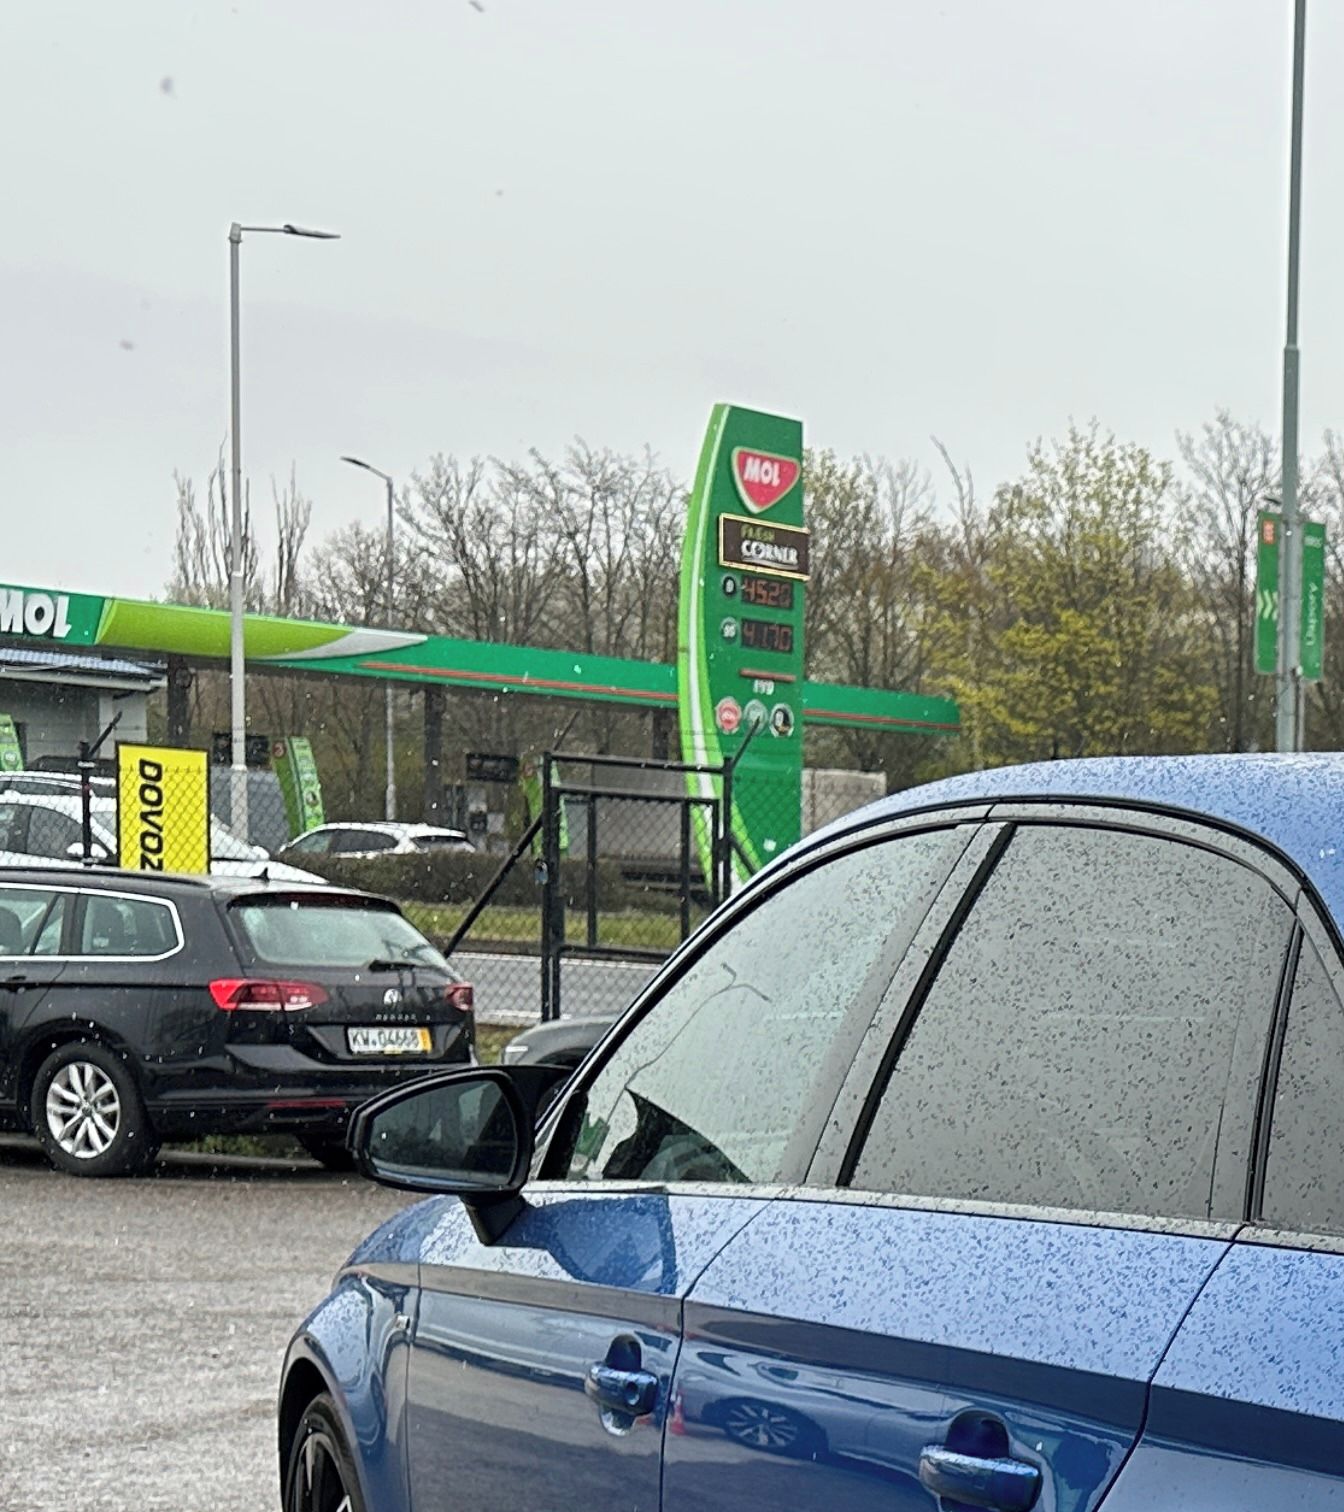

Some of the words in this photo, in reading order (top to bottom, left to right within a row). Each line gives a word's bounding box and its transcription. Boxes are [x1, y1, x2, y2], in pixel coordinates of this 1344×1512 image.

[743, 456, 781, 487] MOL
[741, 540, 799, 566] CORNER
[138, 758, 164, 872] DOVOZ
